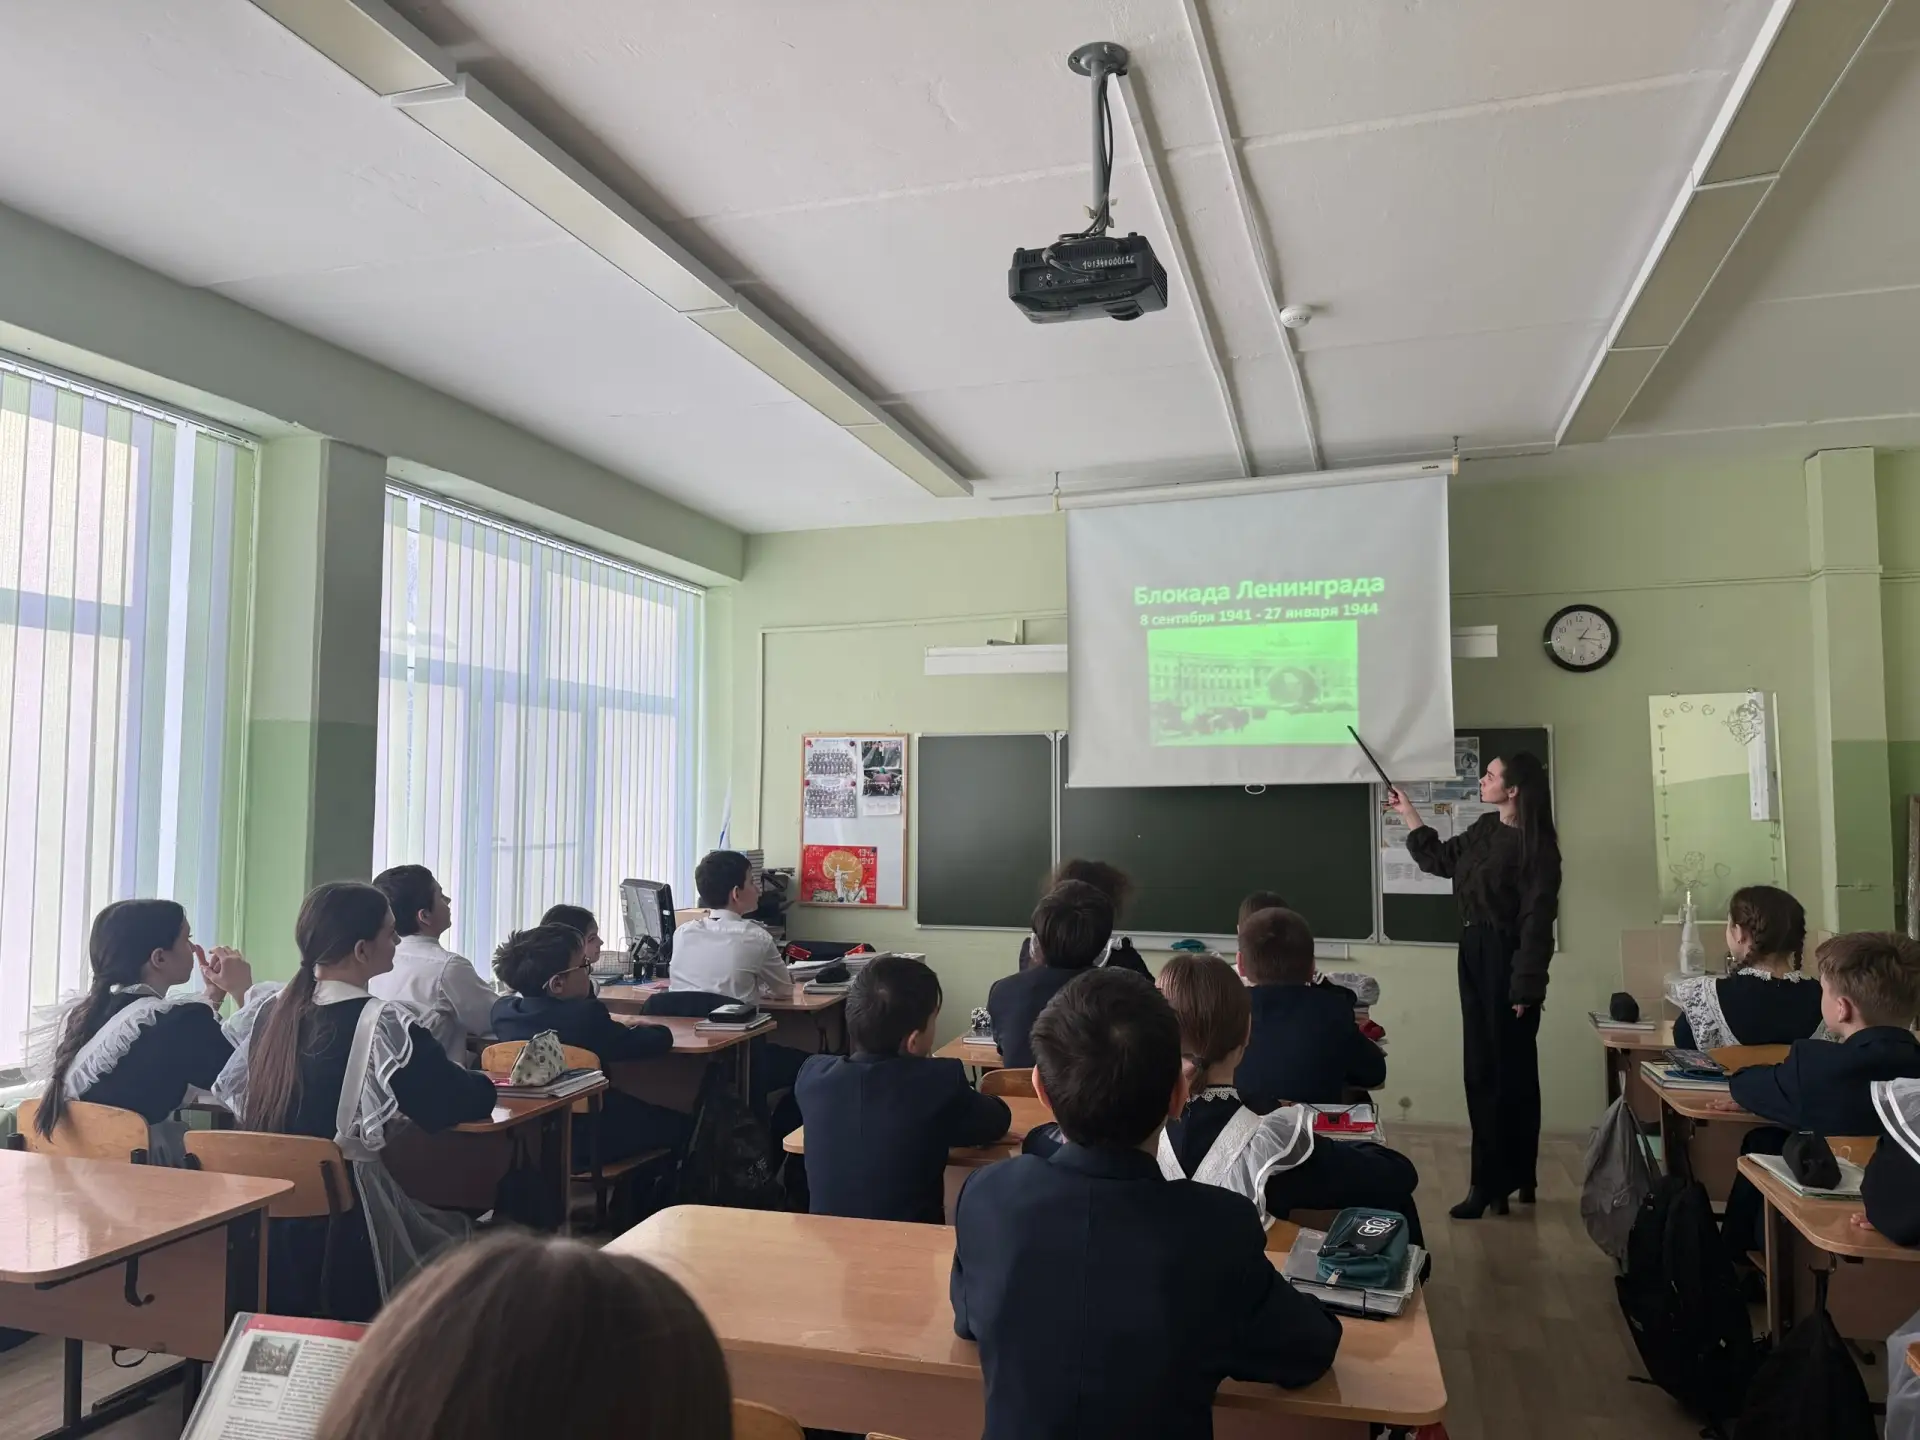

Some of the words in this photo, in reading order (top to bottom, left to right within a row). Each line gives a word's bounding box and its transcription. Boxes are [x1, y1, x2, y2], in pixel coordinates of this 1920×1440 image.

[1133, 584, 1231, 605] Блокада
[1236, 576, 1385, 600] Ленинграда
[1140, 613, 1149, 626] 8
[1152, 610, 1215, 627] сентября
[1219, 608, 1253, 622] 1941
[1264, 607, 1281, 620] 27
[1285, 606, 1339, 620] января
[1343, 602, 1379, 616] 1944
